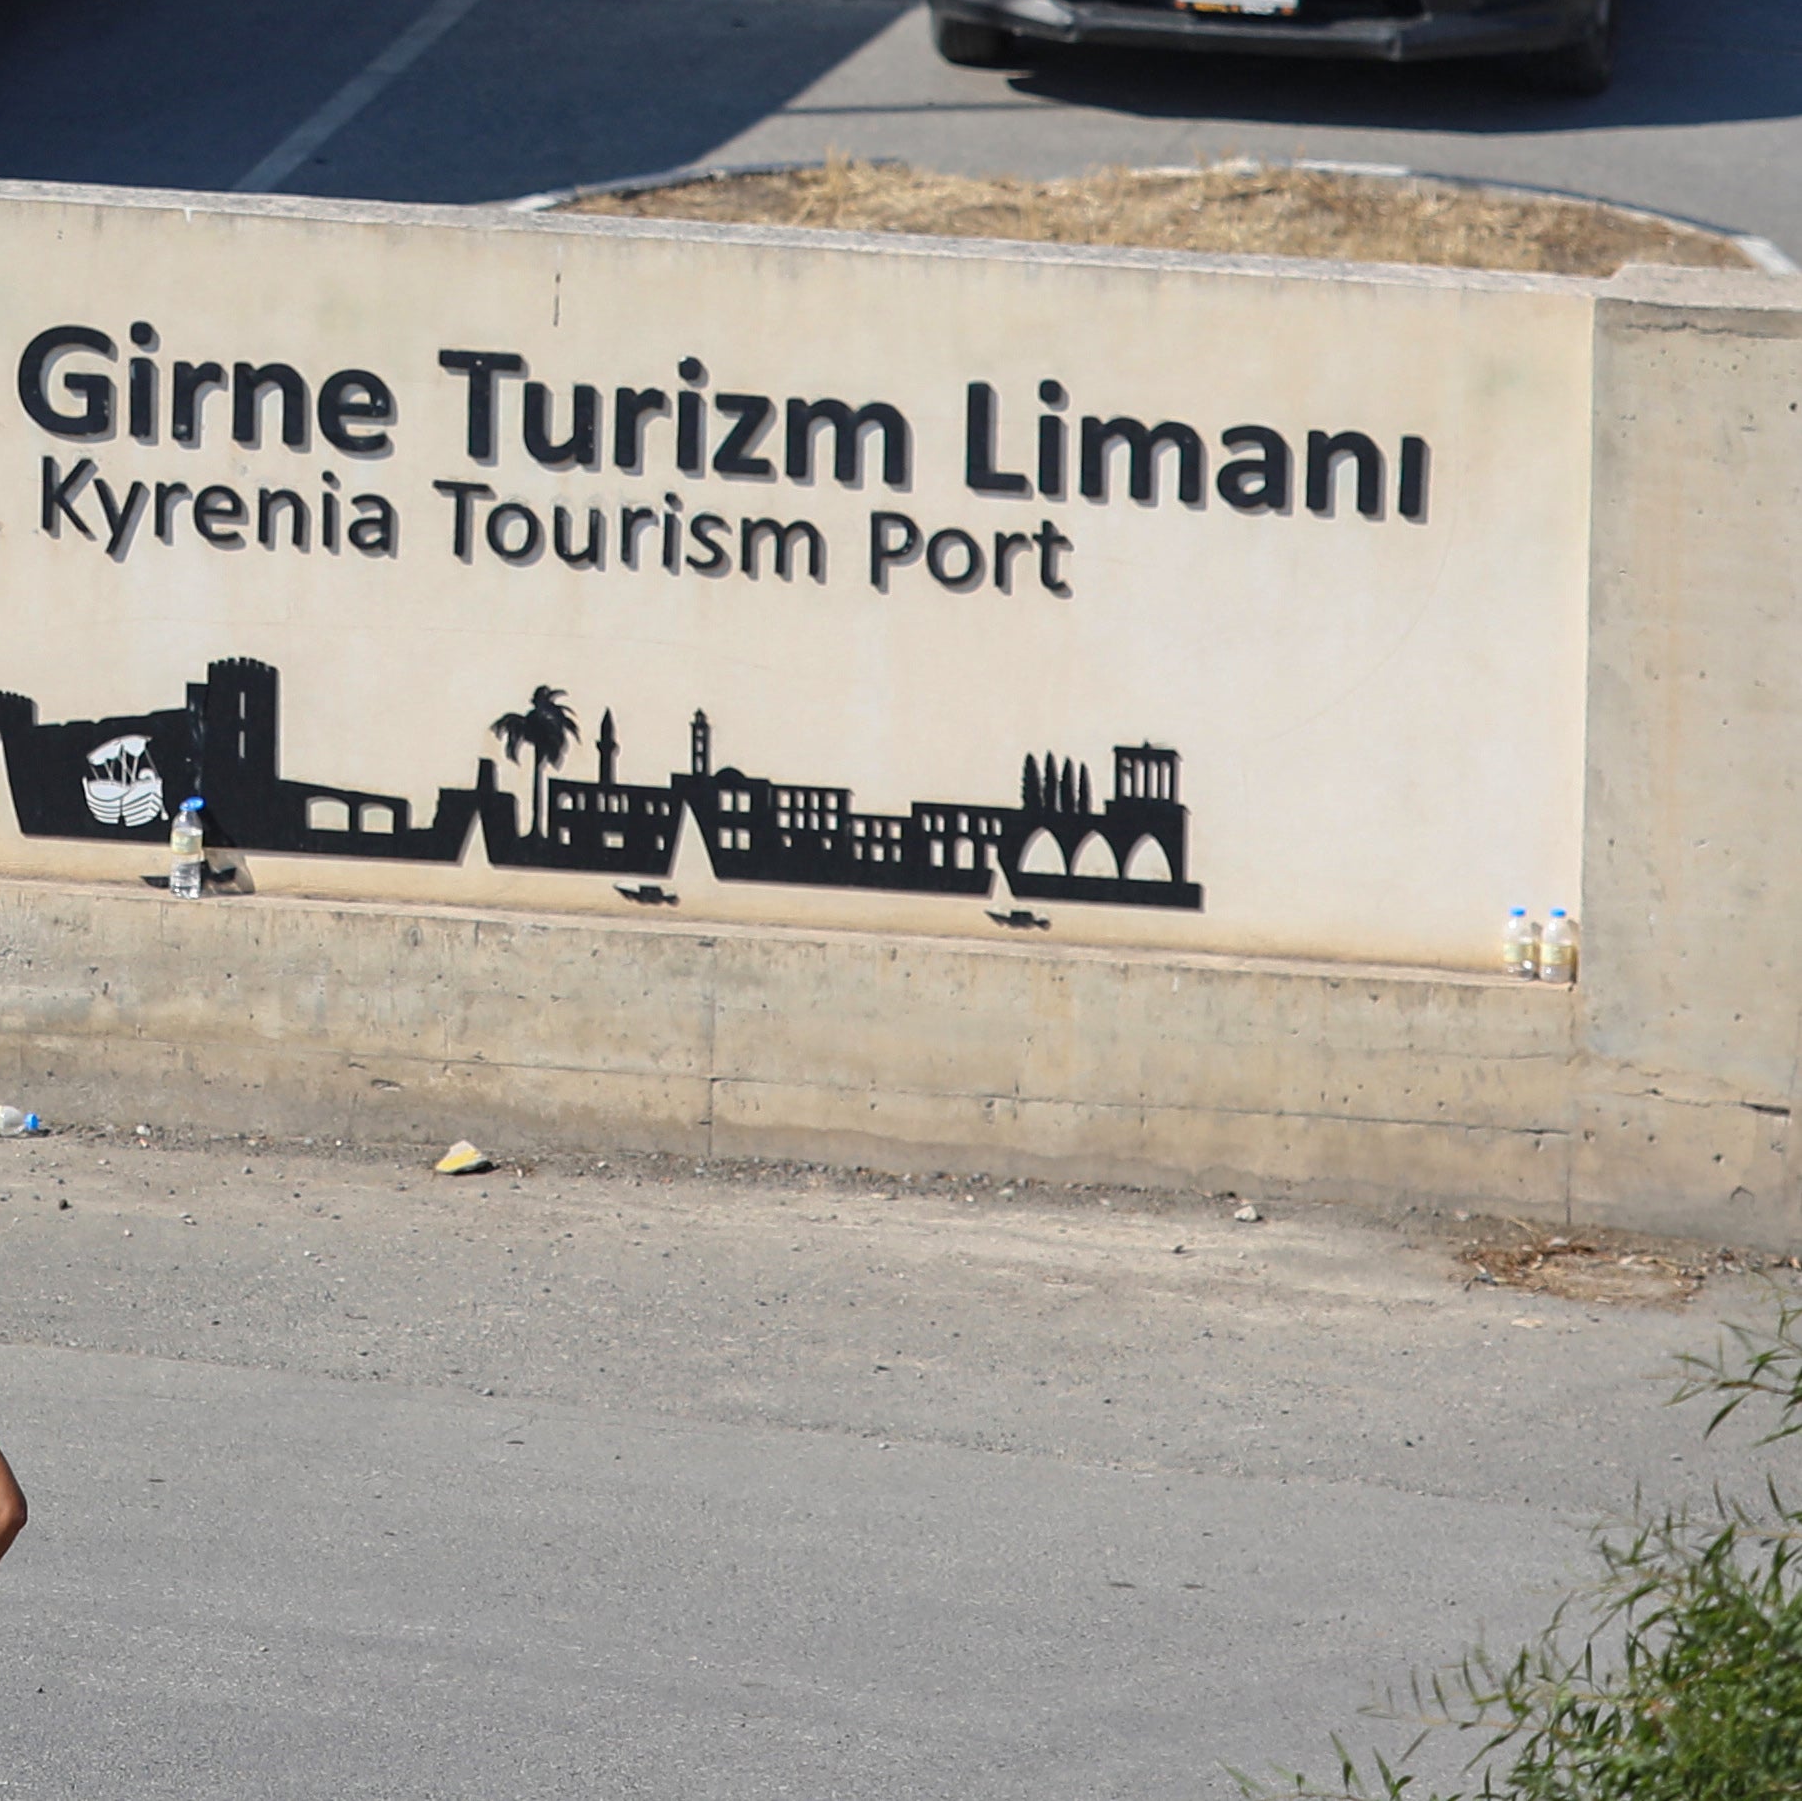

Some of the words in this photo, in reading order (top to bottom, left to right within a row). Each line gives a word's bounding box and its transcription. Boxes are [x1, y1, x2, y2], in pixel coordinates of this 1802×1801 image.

[17, 322, 393, 454] Girne
[437, 350, 910, 488] Turizm
[965, 379, 1428, 522] Limanı
[40, 455, 395, 562] Kyrenia
[434, 482, 822, 583] Tourism
[870, 511, 1072, 598] Port
